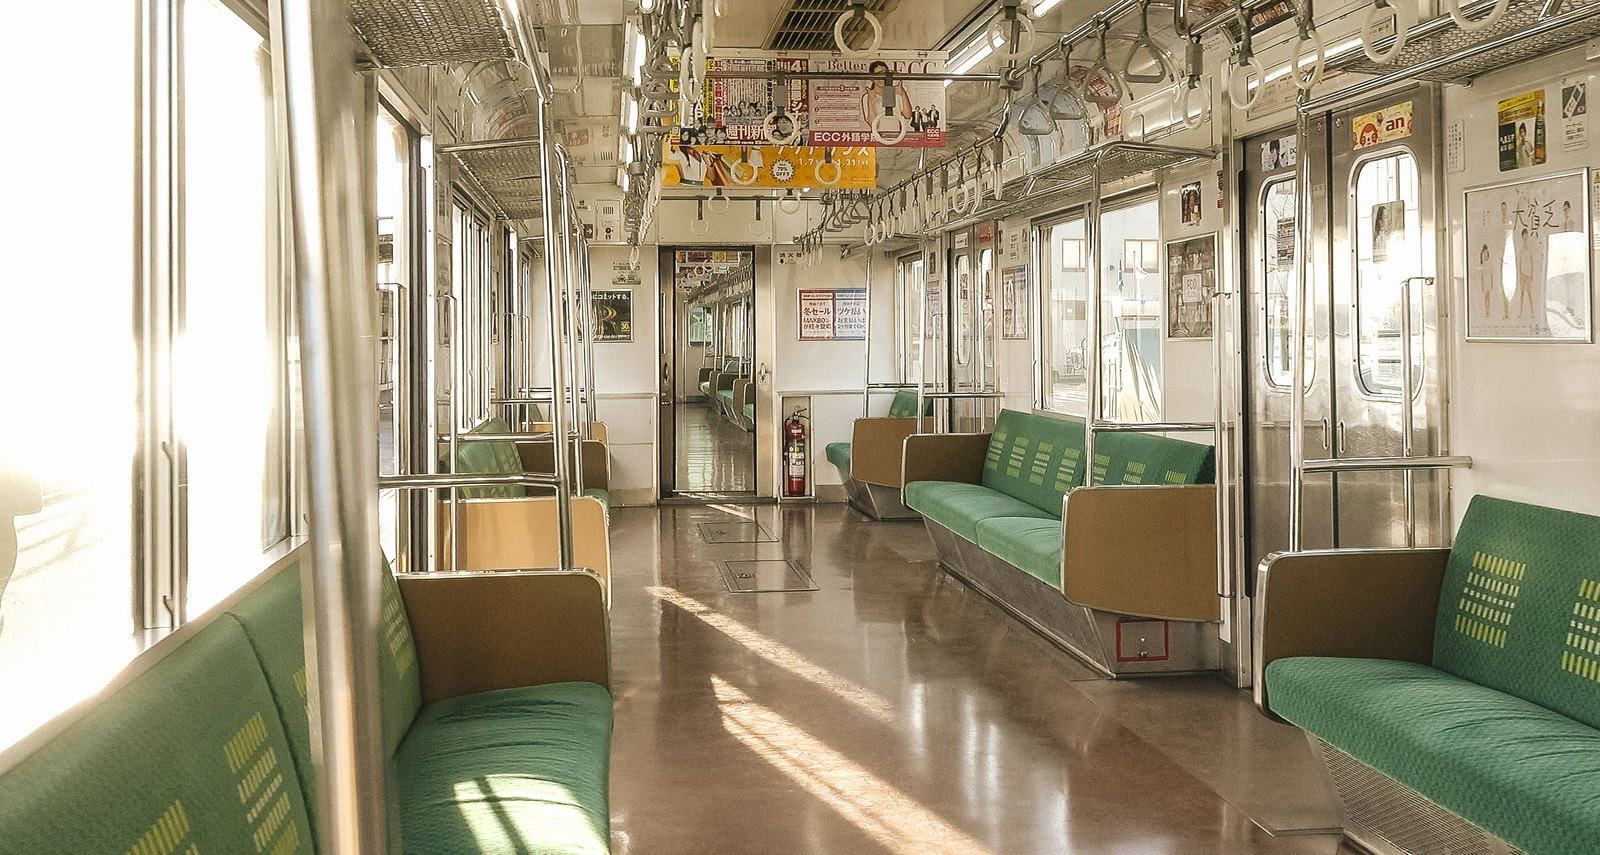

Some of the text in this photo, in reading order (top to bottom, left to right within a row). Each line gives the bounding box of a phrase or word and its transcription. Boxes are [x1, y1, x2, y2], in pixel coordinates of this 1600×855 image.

[827, 60, 866, 70] Better
[1385, 116, 1405, 132] an
[726, 125, 775, 140] 週刊新
[798, 158, 814, 166] 1.7
[1511, 199, 1560, 238] 大貧乏
[803, 307, 831, 315] 冬セール
